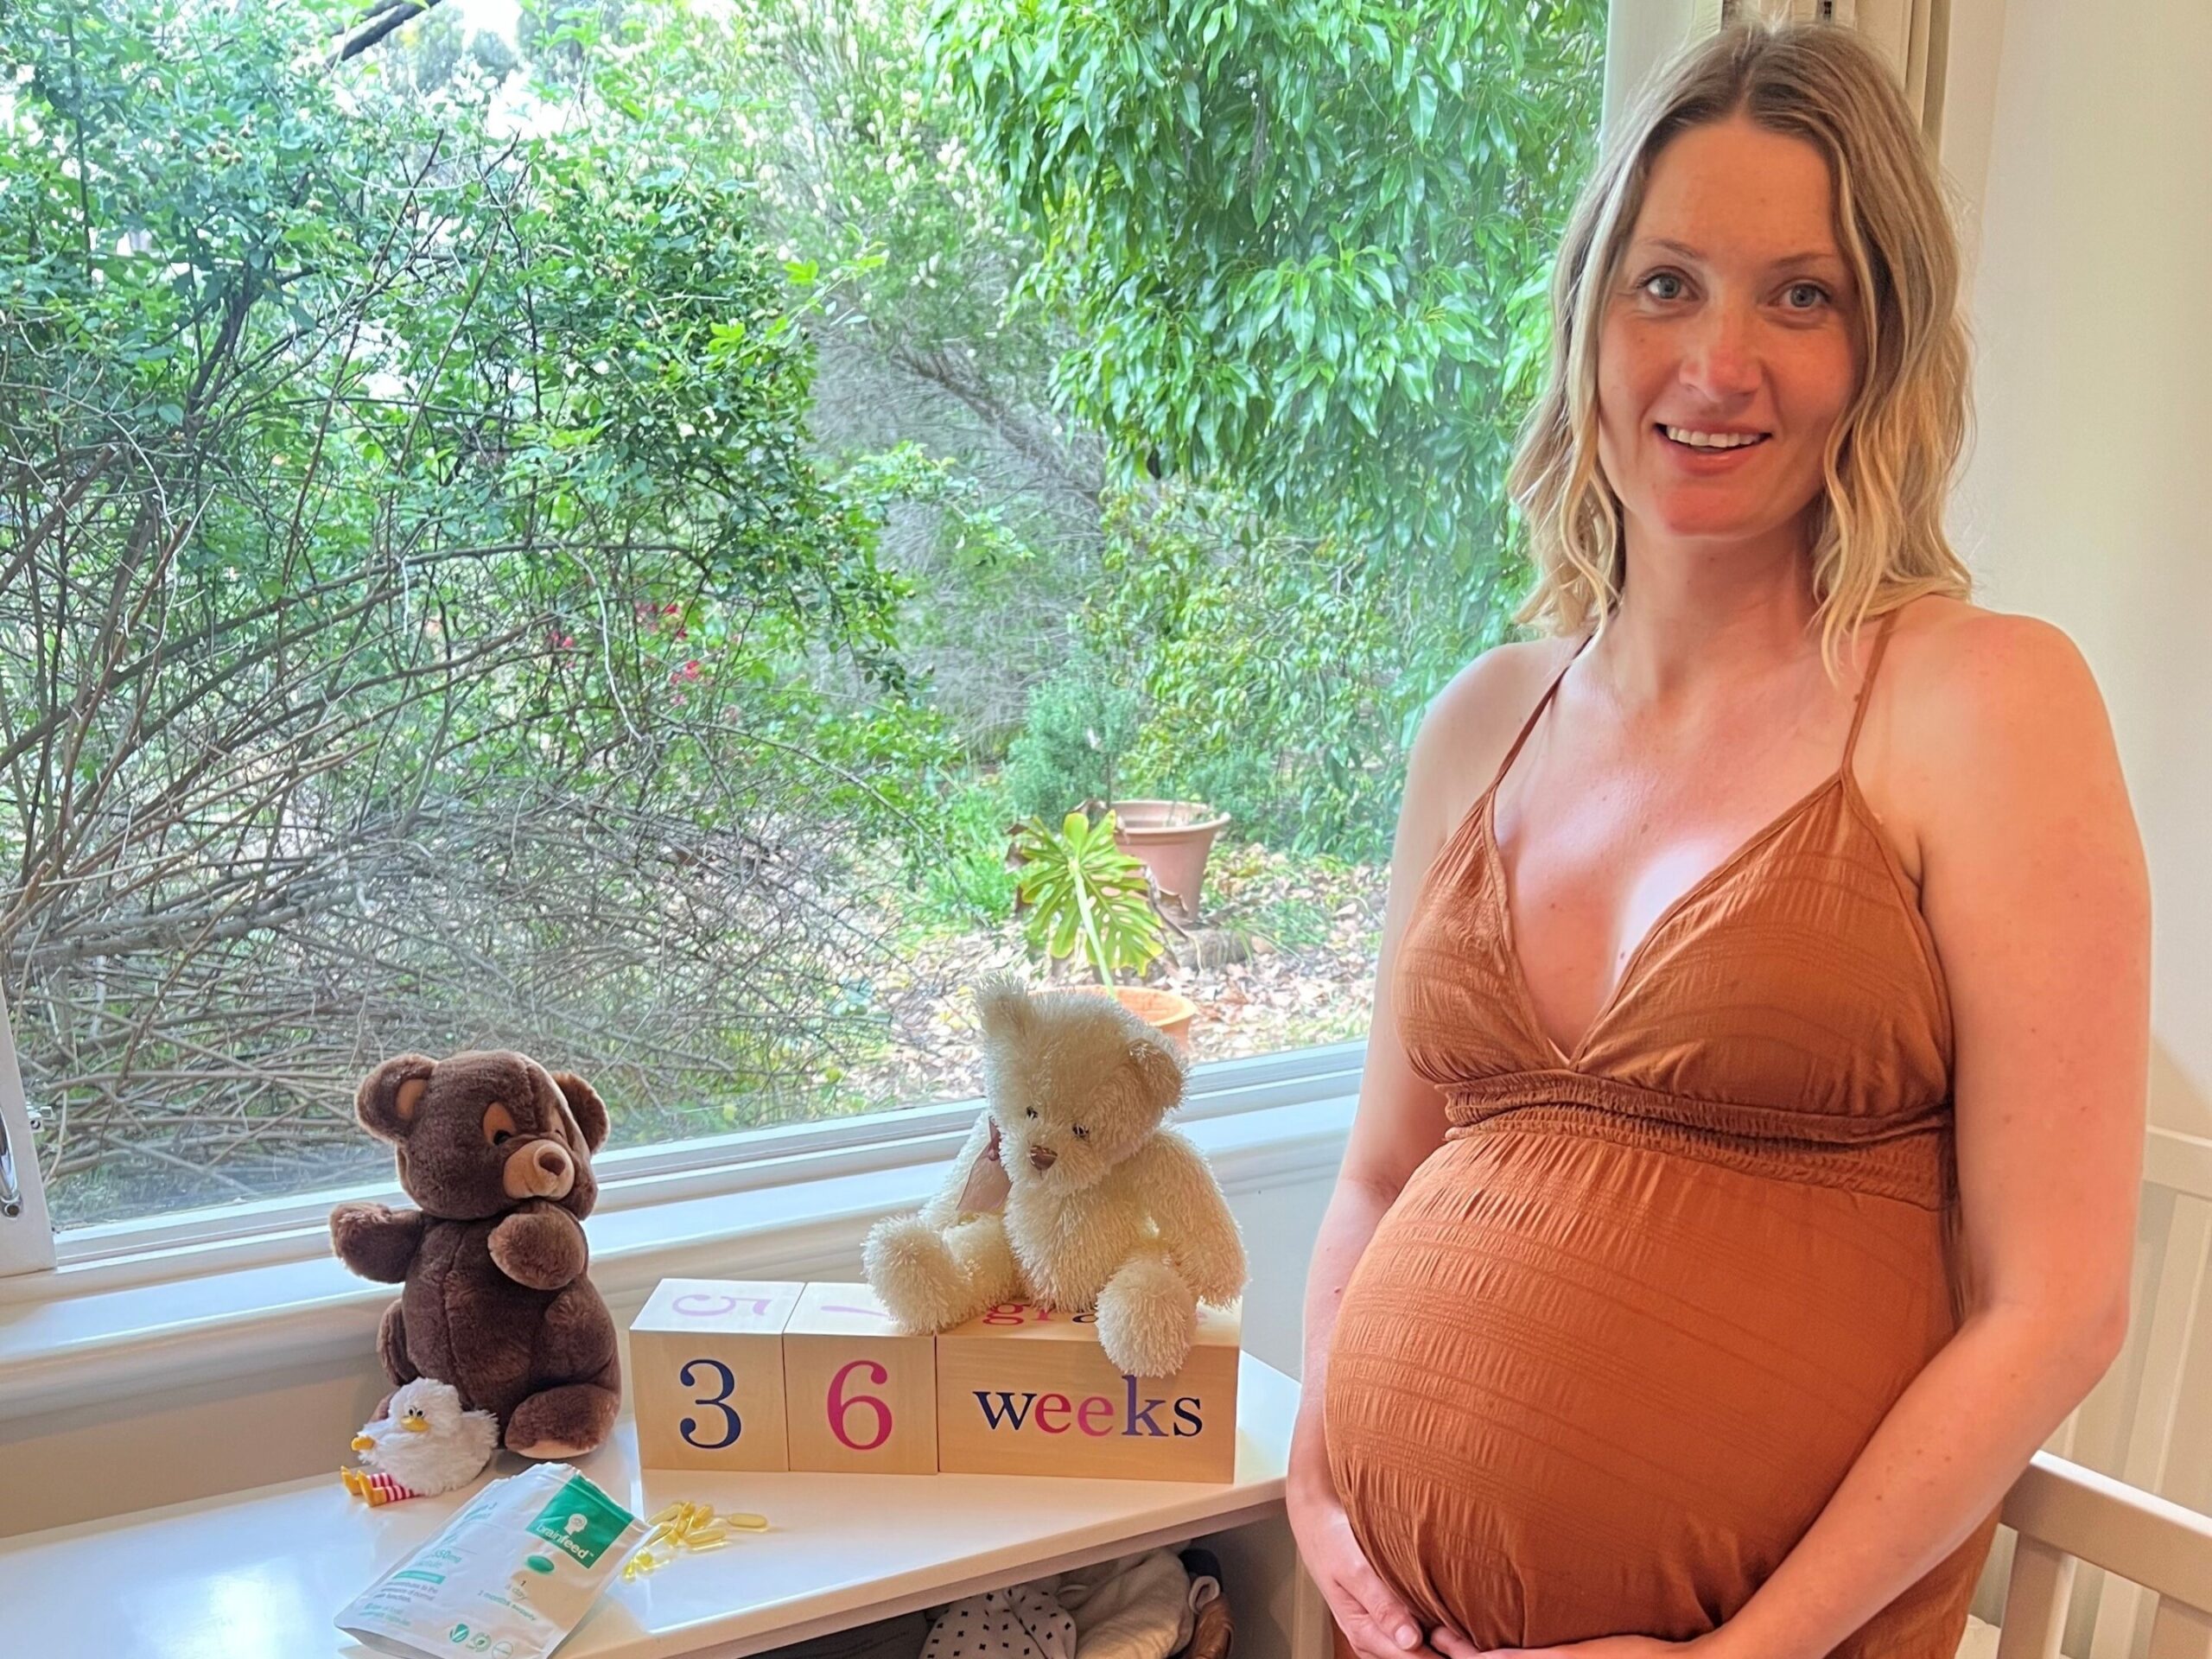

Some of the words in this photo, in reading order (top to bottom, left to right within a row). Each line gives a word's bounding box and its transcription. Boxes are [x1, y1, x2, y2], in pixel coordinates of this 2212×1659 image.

[680, 1359, 741, 1449] 3
[827, 1360, 893, 1451] 6
[972, 1374, 1203, 1437] weeks
